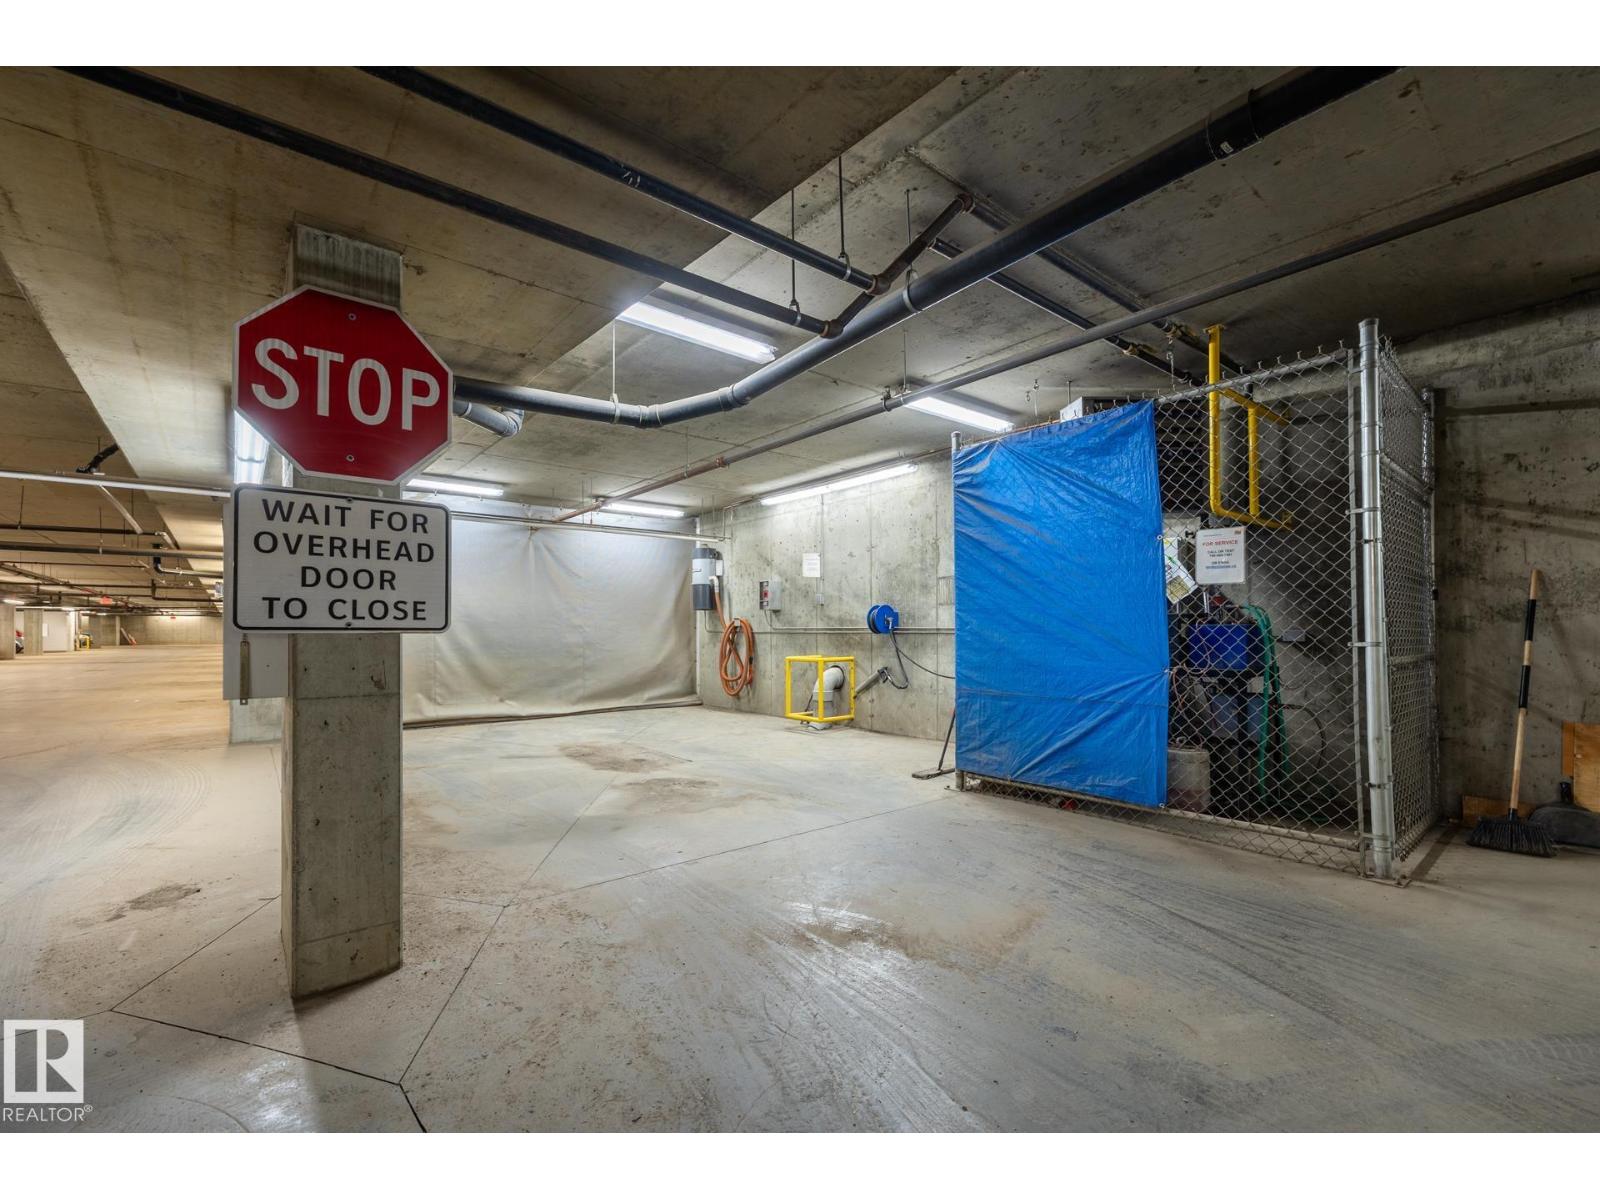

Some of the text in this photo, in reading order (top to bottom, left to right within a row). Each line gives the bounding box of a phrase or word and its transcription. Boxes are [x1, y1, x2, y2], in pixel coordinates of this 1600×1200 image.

[251, 338, 441, 431] STOP
[261, 498, 429, 535] WAIT FOR
[253, 530, 435, 563] OVERHEAD
[300, 565, 397, 591] DOOR
[261, 596, 427, 621] TO CLOSE
